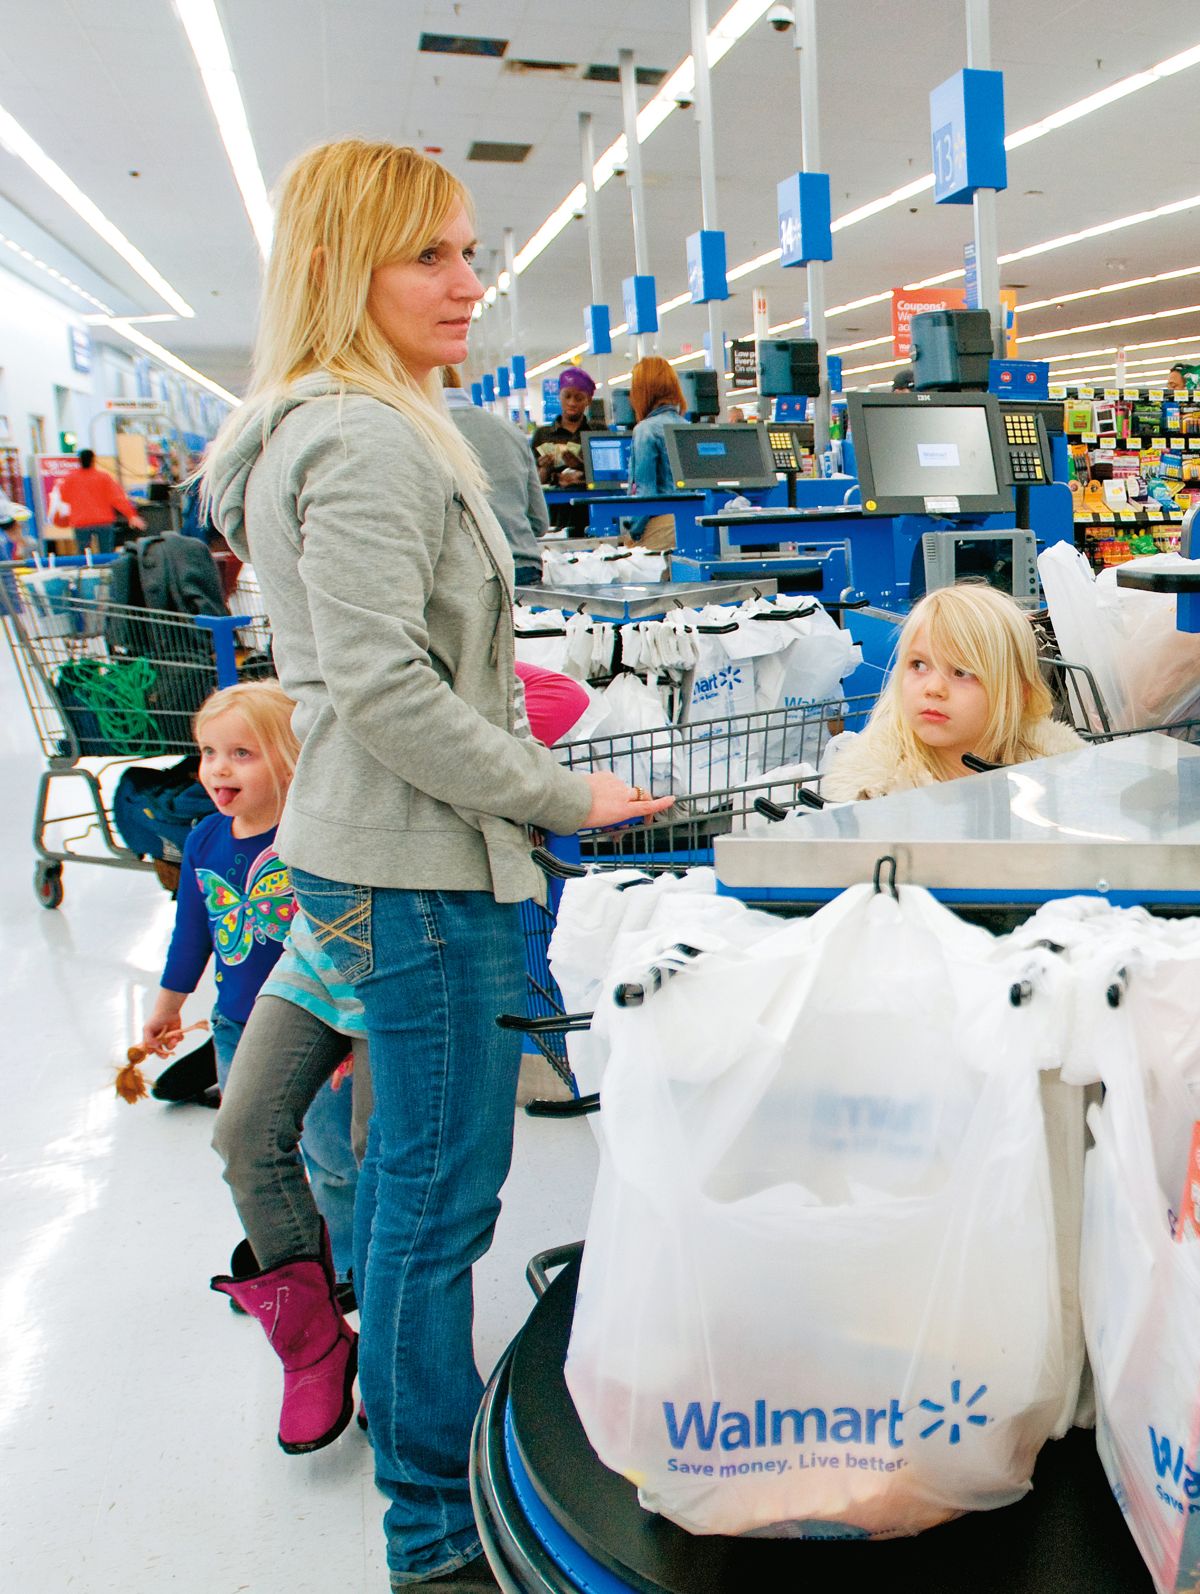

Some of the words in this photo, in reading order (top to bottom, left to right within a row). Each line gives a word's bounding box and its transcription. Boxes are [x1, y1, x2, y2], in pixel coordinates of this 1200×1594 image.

[936, 134, 954, 185] 13
[897, 300, 947, 314] Coupons?
[663, 1399, 905, 1451] Walmart
[667, 1458, 714, 1477] Save
[719, 1457, 793, 1478] money.
[799, 1453, 840, 1469] Live
[845, 1453, 909, 1473] better.
